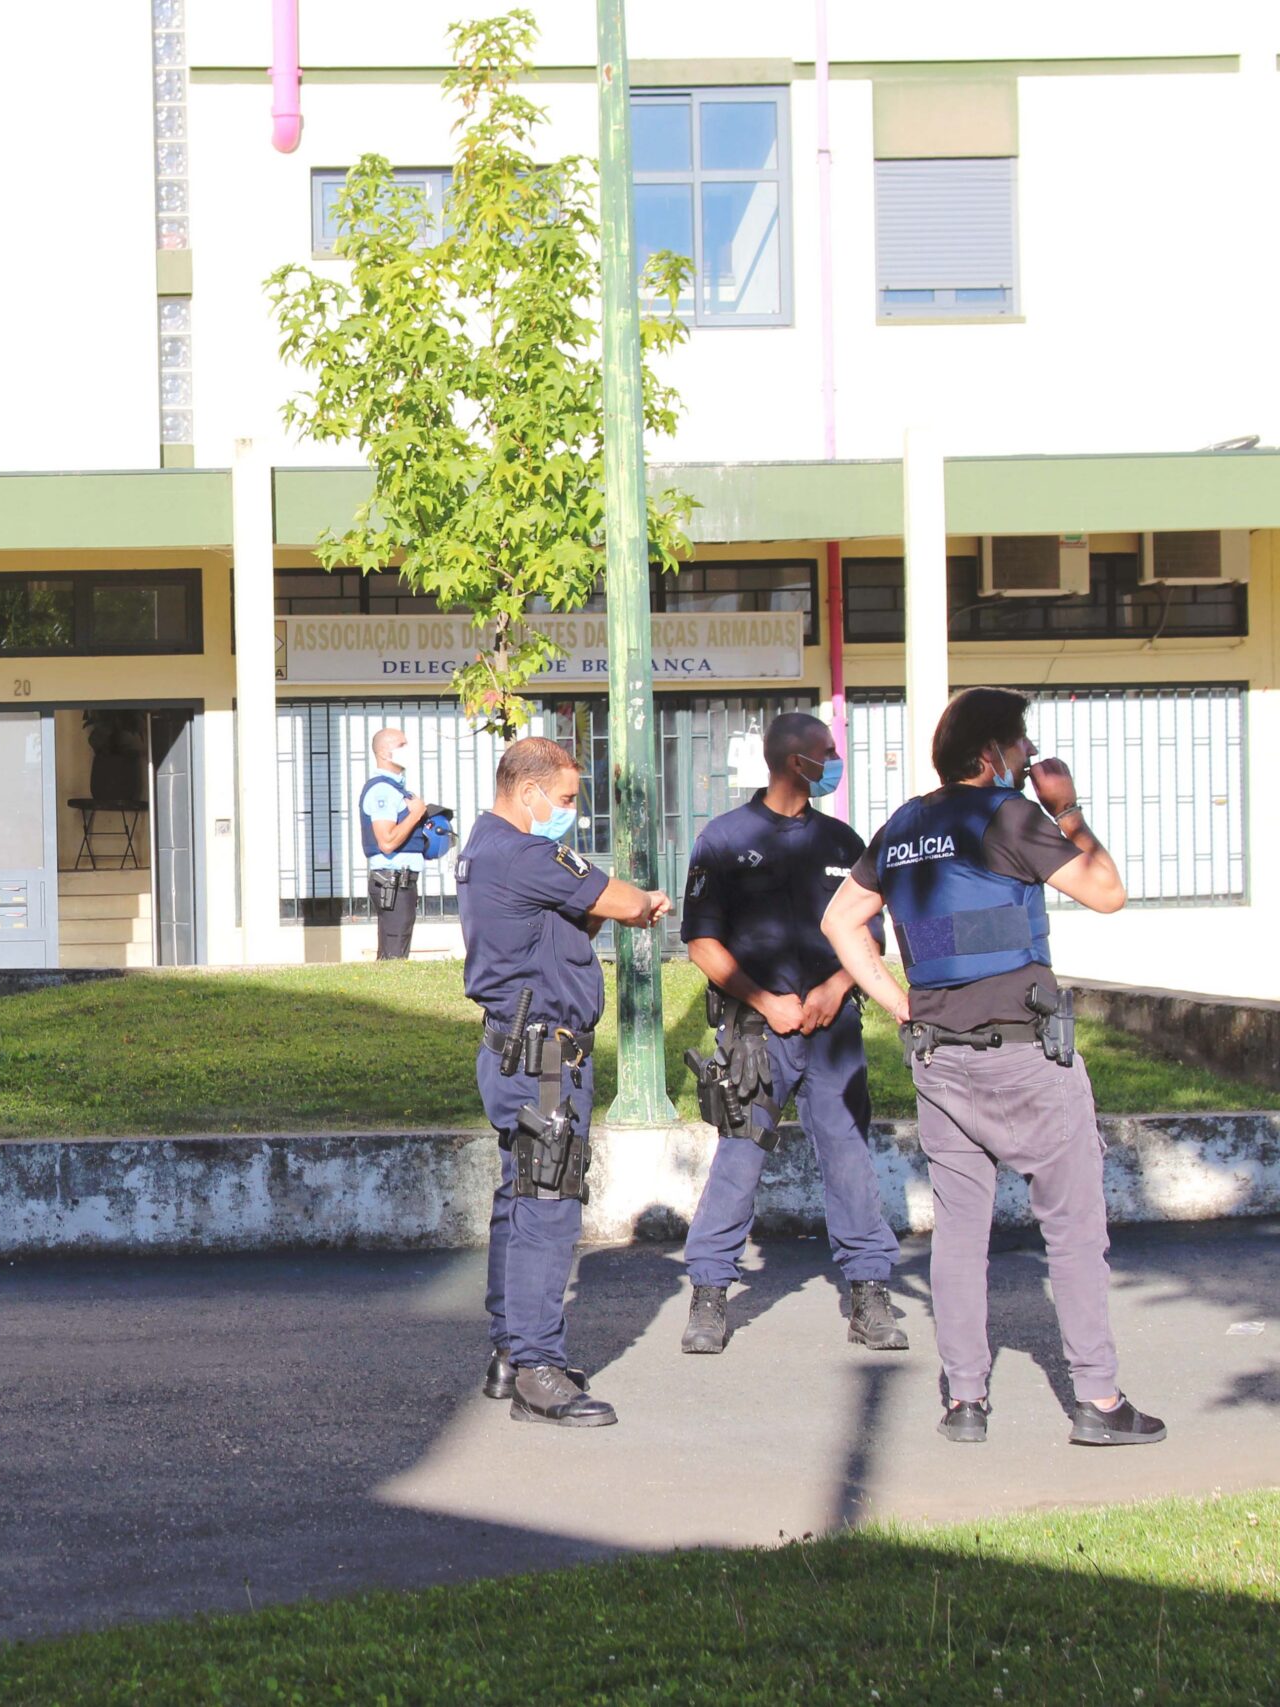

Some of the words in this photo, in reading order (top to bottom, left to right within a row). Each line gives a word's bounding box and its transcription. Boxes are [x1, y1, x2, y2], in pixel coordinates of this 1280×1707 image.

[293, 619, 410, 657] ASSOCIAÇÃO
[417, 621, 454, 650] DOS
[583, 621, 609, 649] DA
[707, 619, 795, 649] ARMADAS
[383, 660, 470, 674] DELEGA
[582, 658, 712, 674] BRANÇA
[14, 679, 31, 697] 20
[886, 835, 955, 863] POLÍCIA
